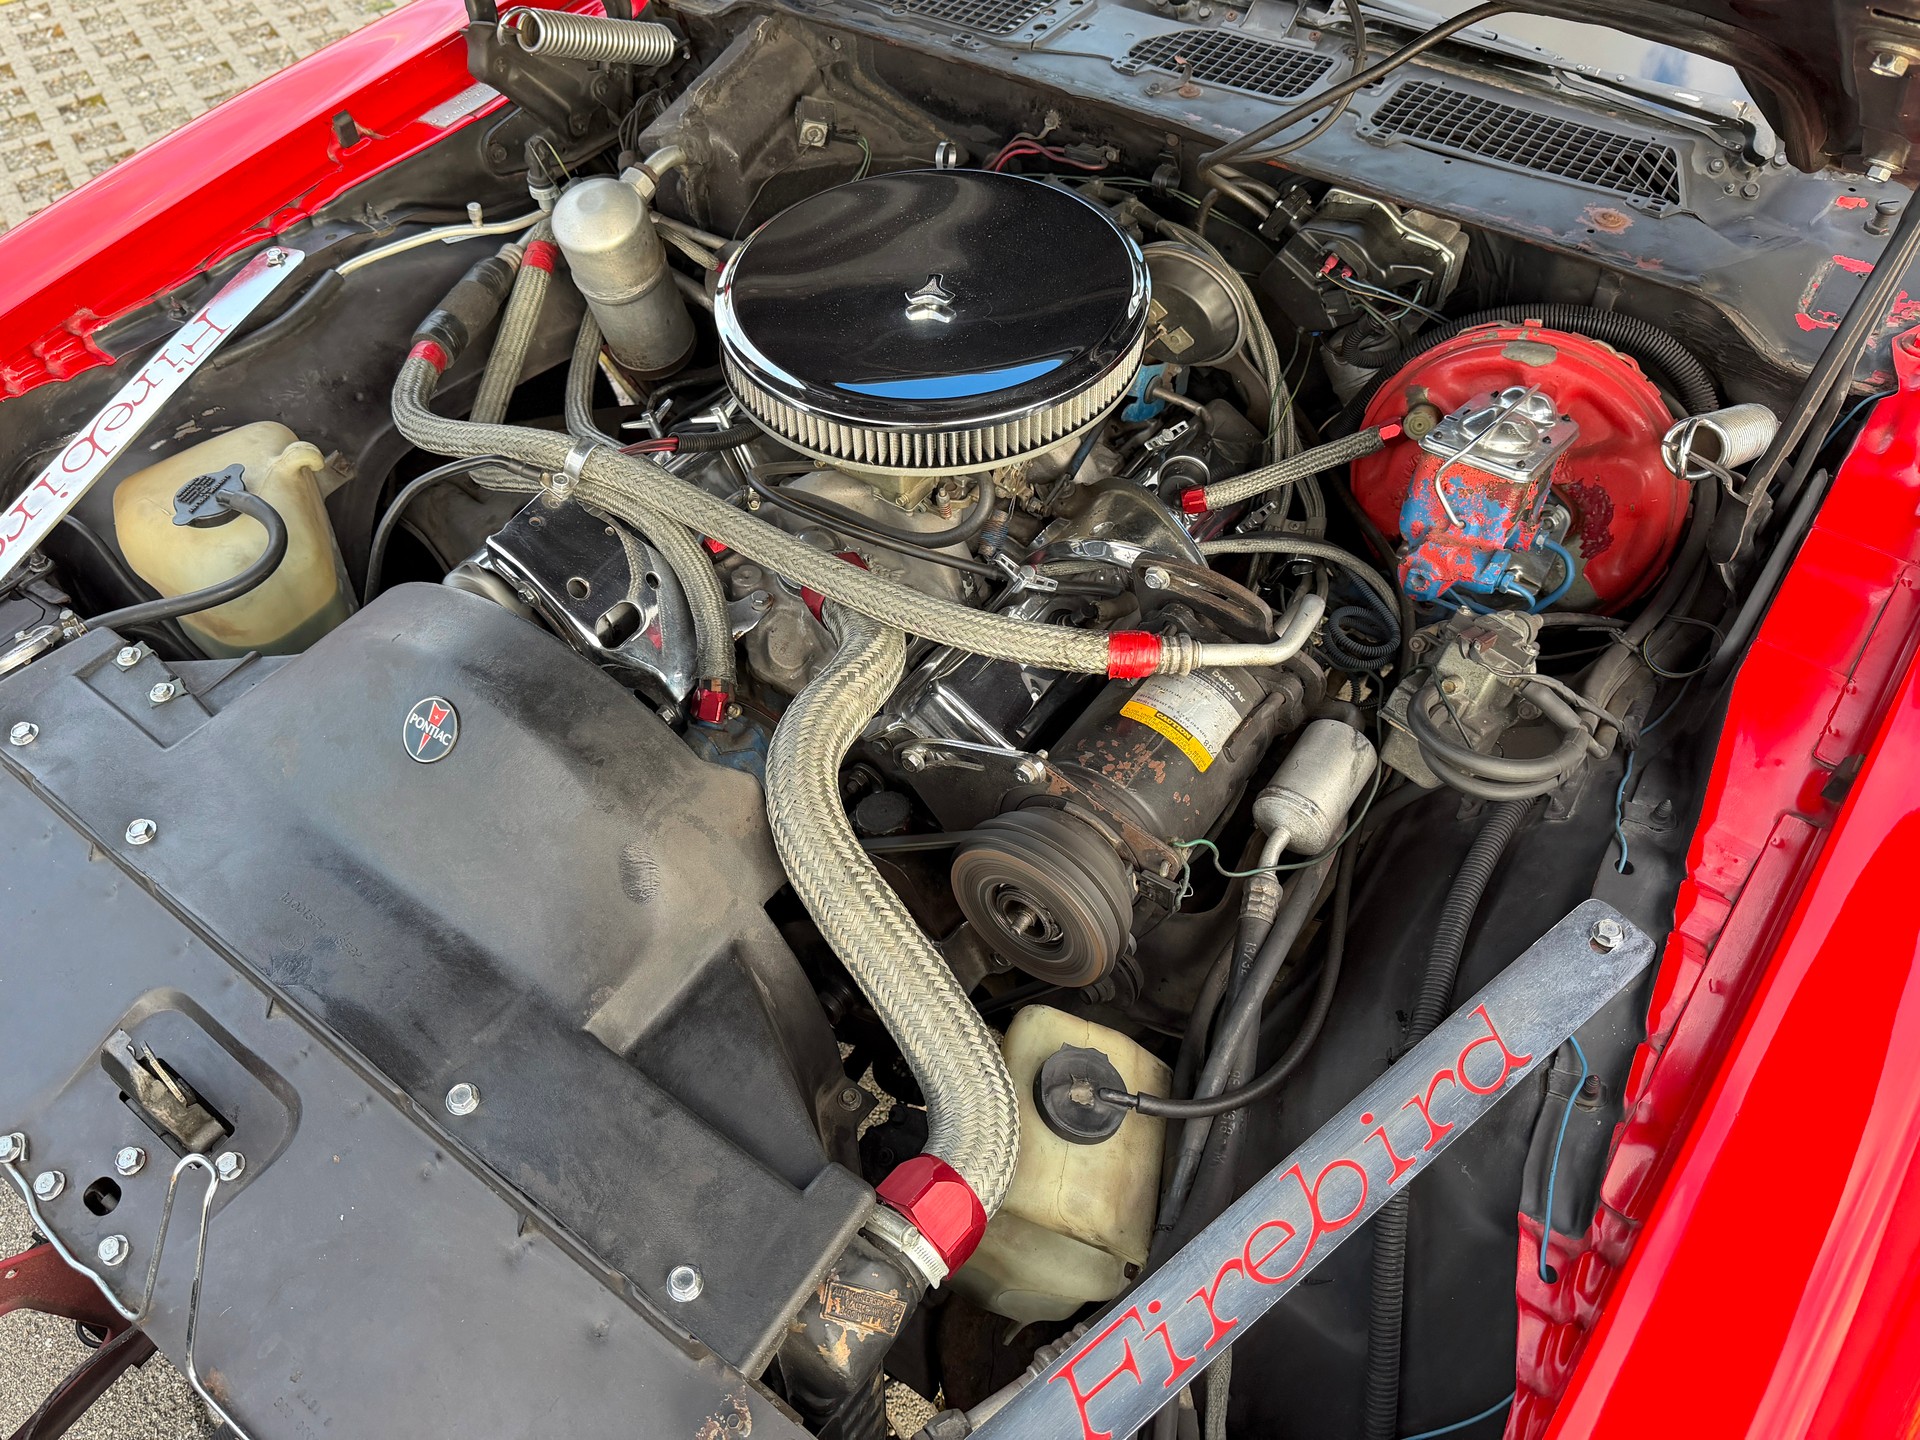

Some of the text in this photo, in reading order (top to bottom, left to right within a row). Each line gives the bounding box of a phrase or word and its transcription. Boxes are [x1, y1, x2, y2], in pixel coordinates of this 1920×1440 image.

[0, 308, 232, 556] Firebir
[1212, 671, 1246, 703] Delco Air
[409, 712, 452, 746] PONTIAC
[1156, 711, 1190, 738] CAUTION
[1047, 1005, 1533, 1440] Firebird
